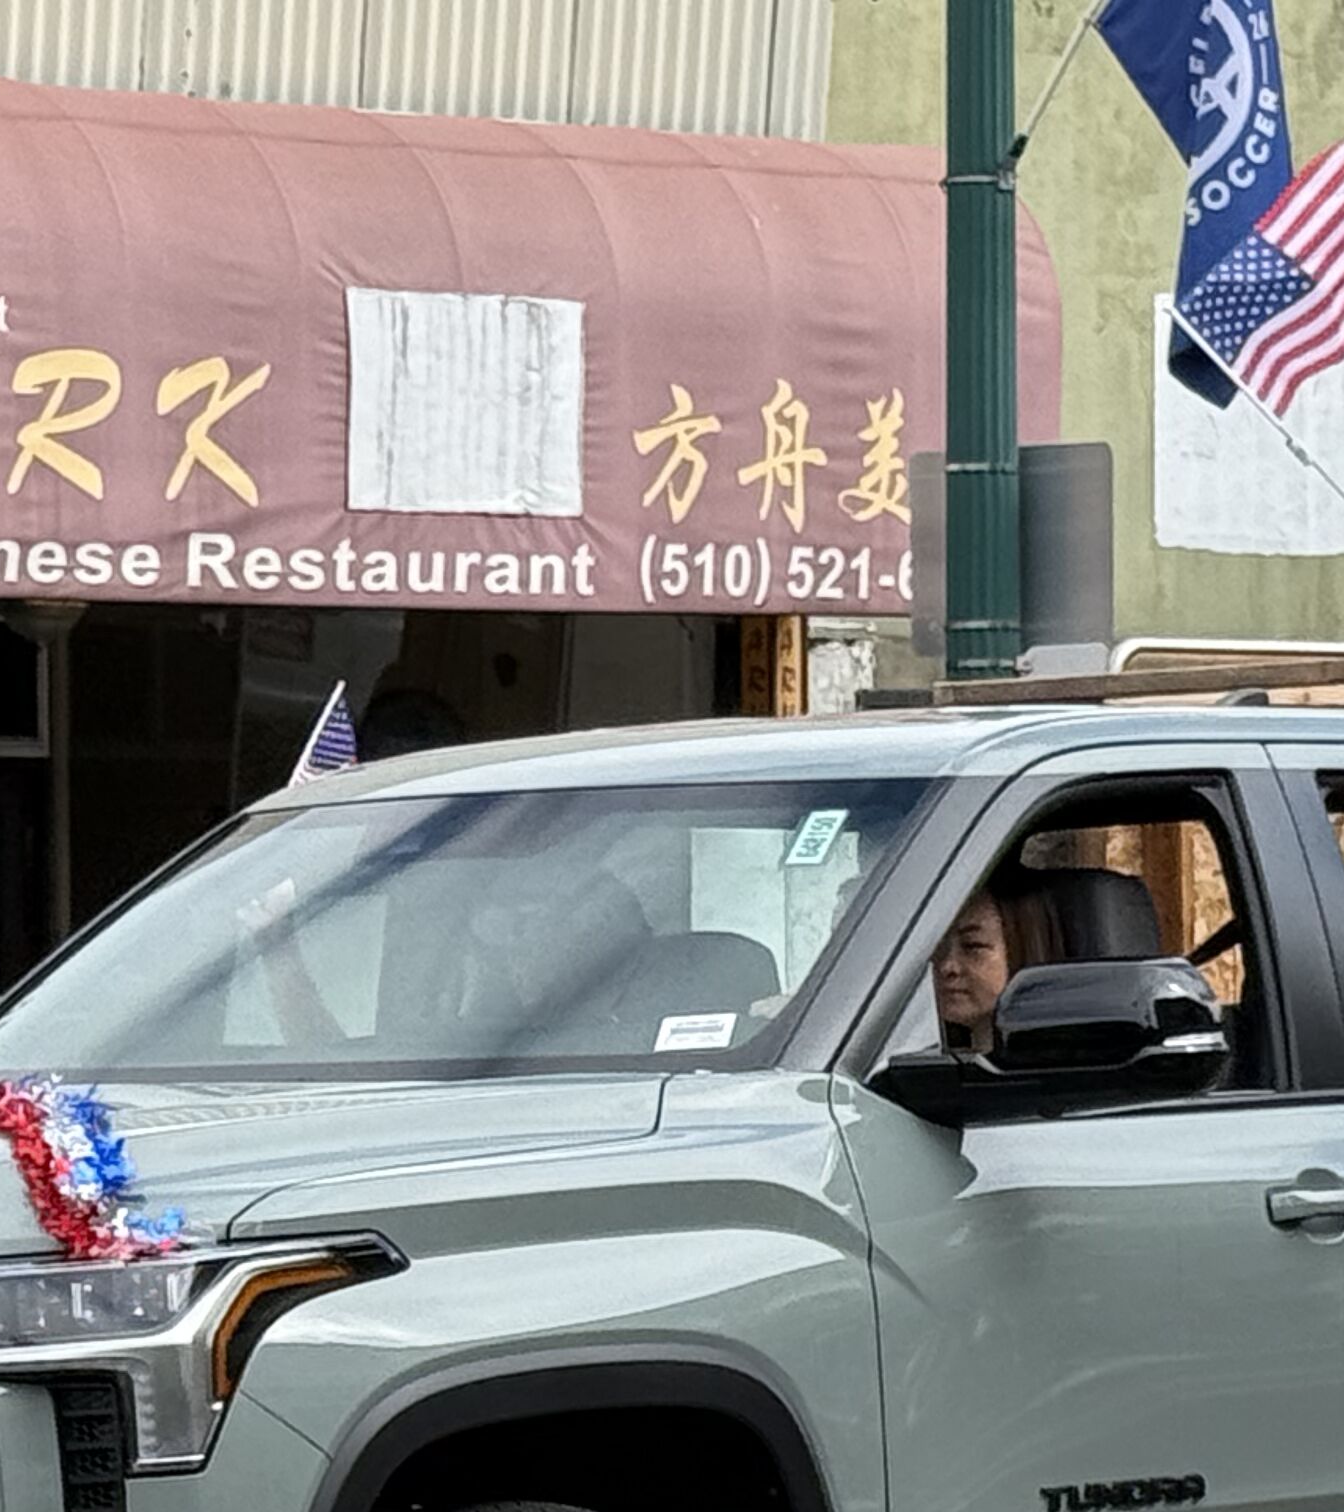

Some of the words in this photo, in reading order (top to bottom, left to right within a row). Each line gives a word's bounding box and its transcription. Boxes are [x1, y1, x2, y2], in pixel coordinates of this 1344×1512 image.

[1186, 87, 1280, 226] SOCCER
[187, 532, 595, 597] Restaurant
[640, 534, 772, 606] (510)
